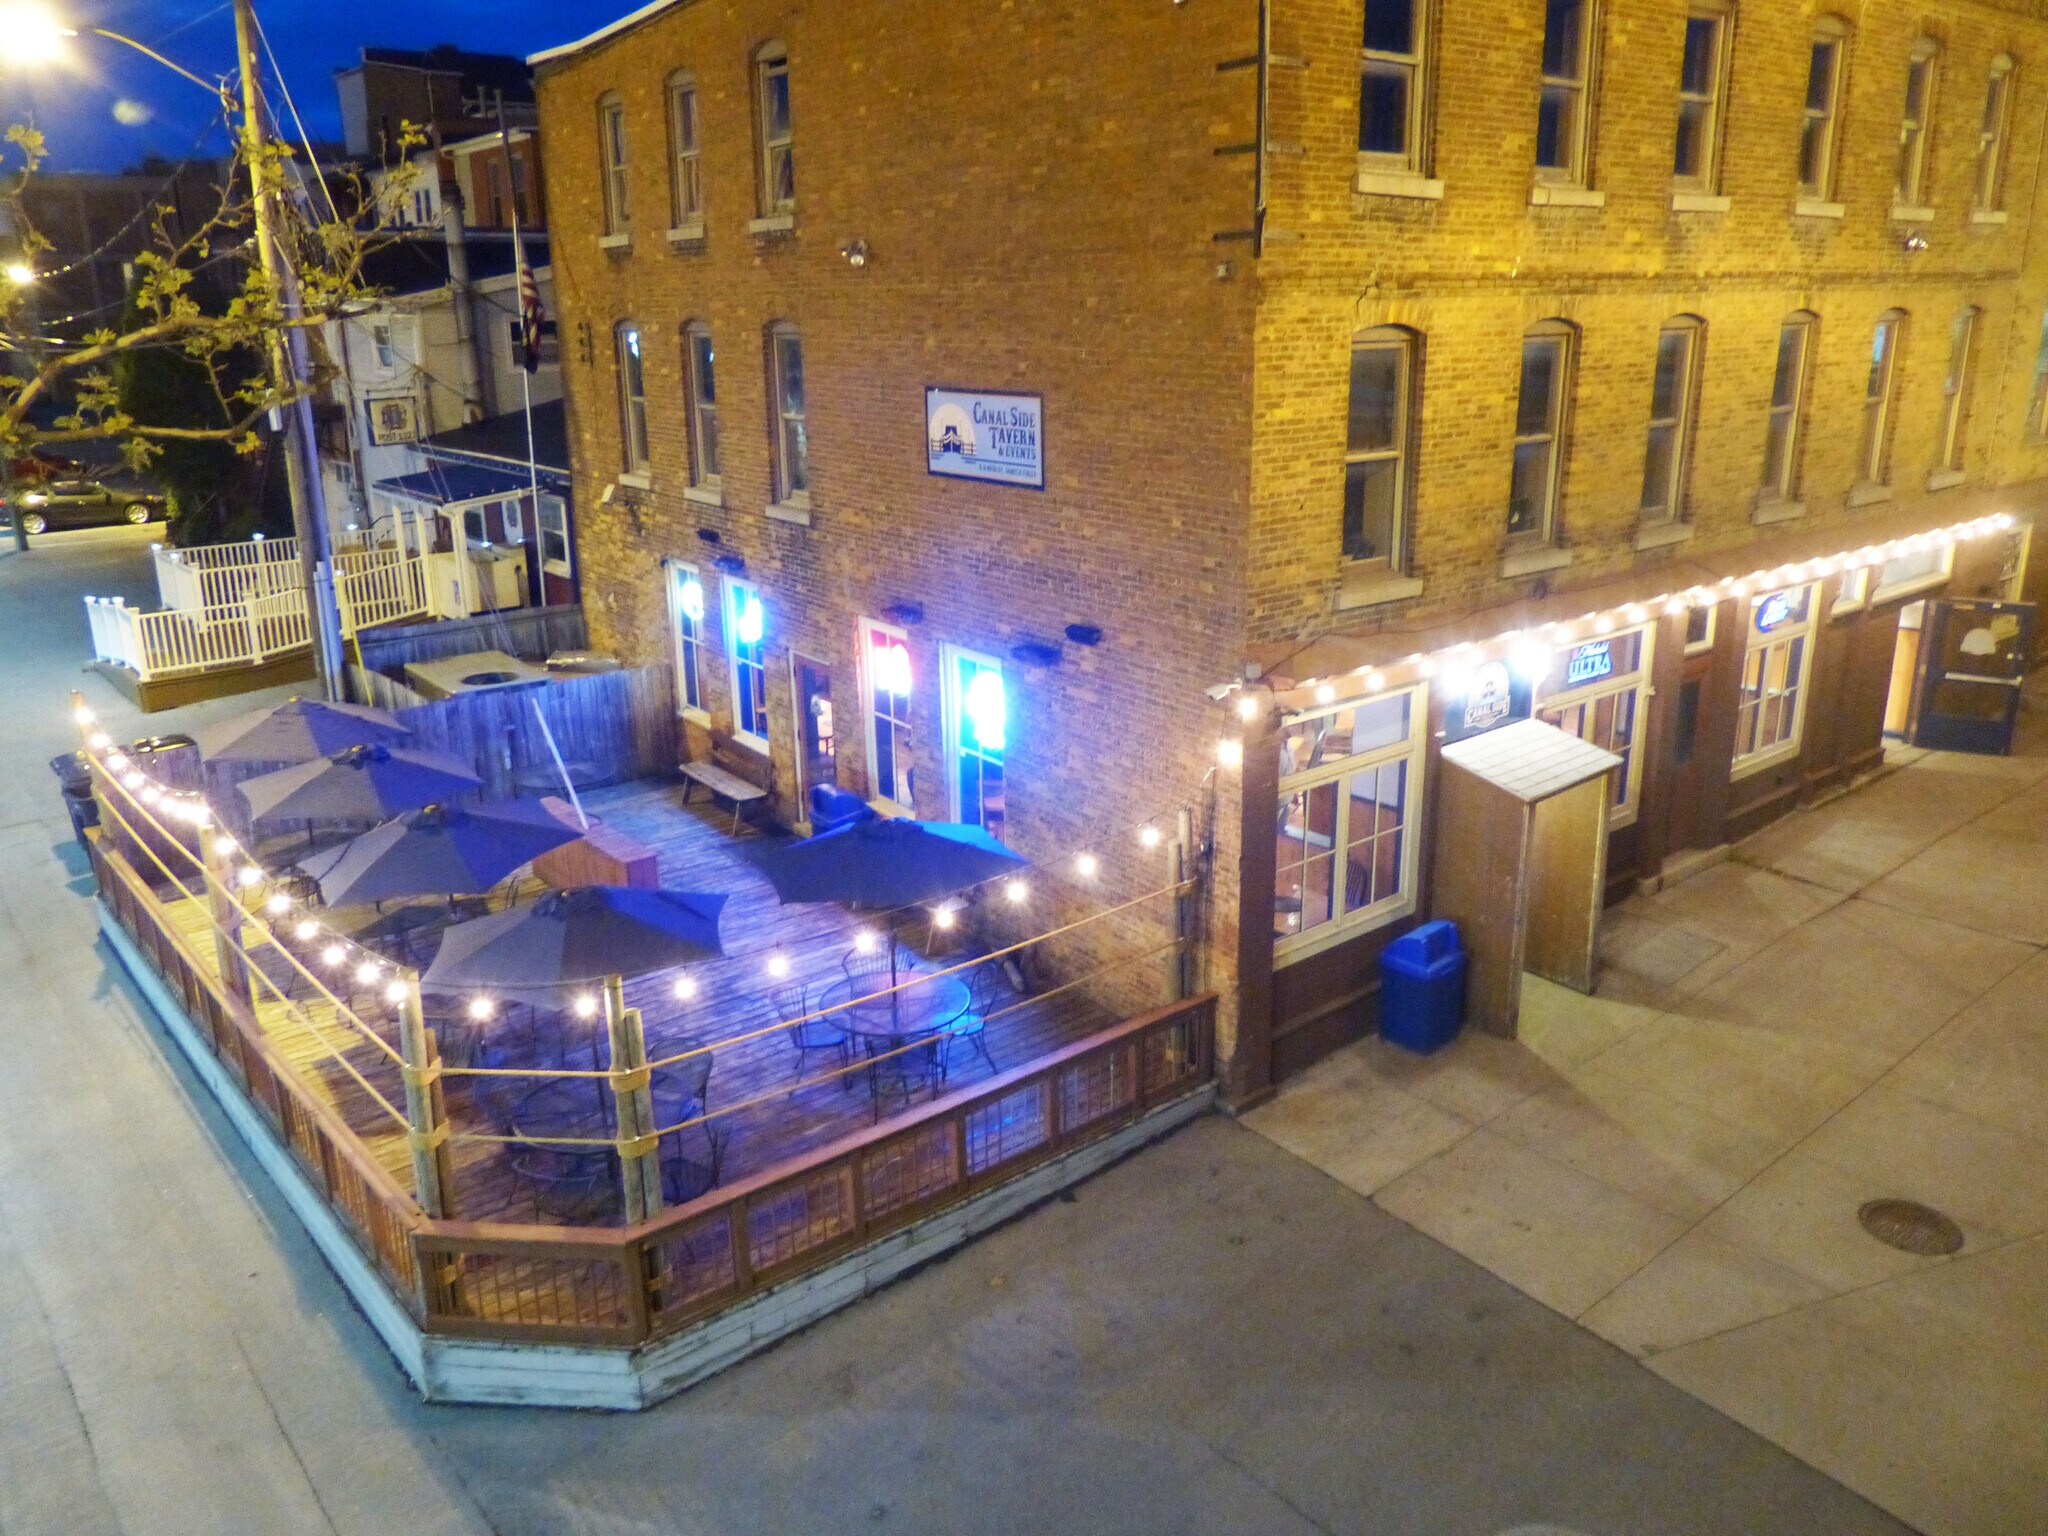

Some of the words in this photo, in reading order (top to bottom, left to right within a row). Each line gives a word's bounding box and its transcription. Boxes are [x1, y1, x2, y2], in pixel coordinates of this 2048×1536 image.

[973, 402, 1008, 426] CANAL
[1010, 407, 1036, 428] SIDE
[988, 427, 1036, 449] TAVERN
[1005, 447, 1037, 460] EVENTS
[1568, 653, 1611, 676] ULTRA
